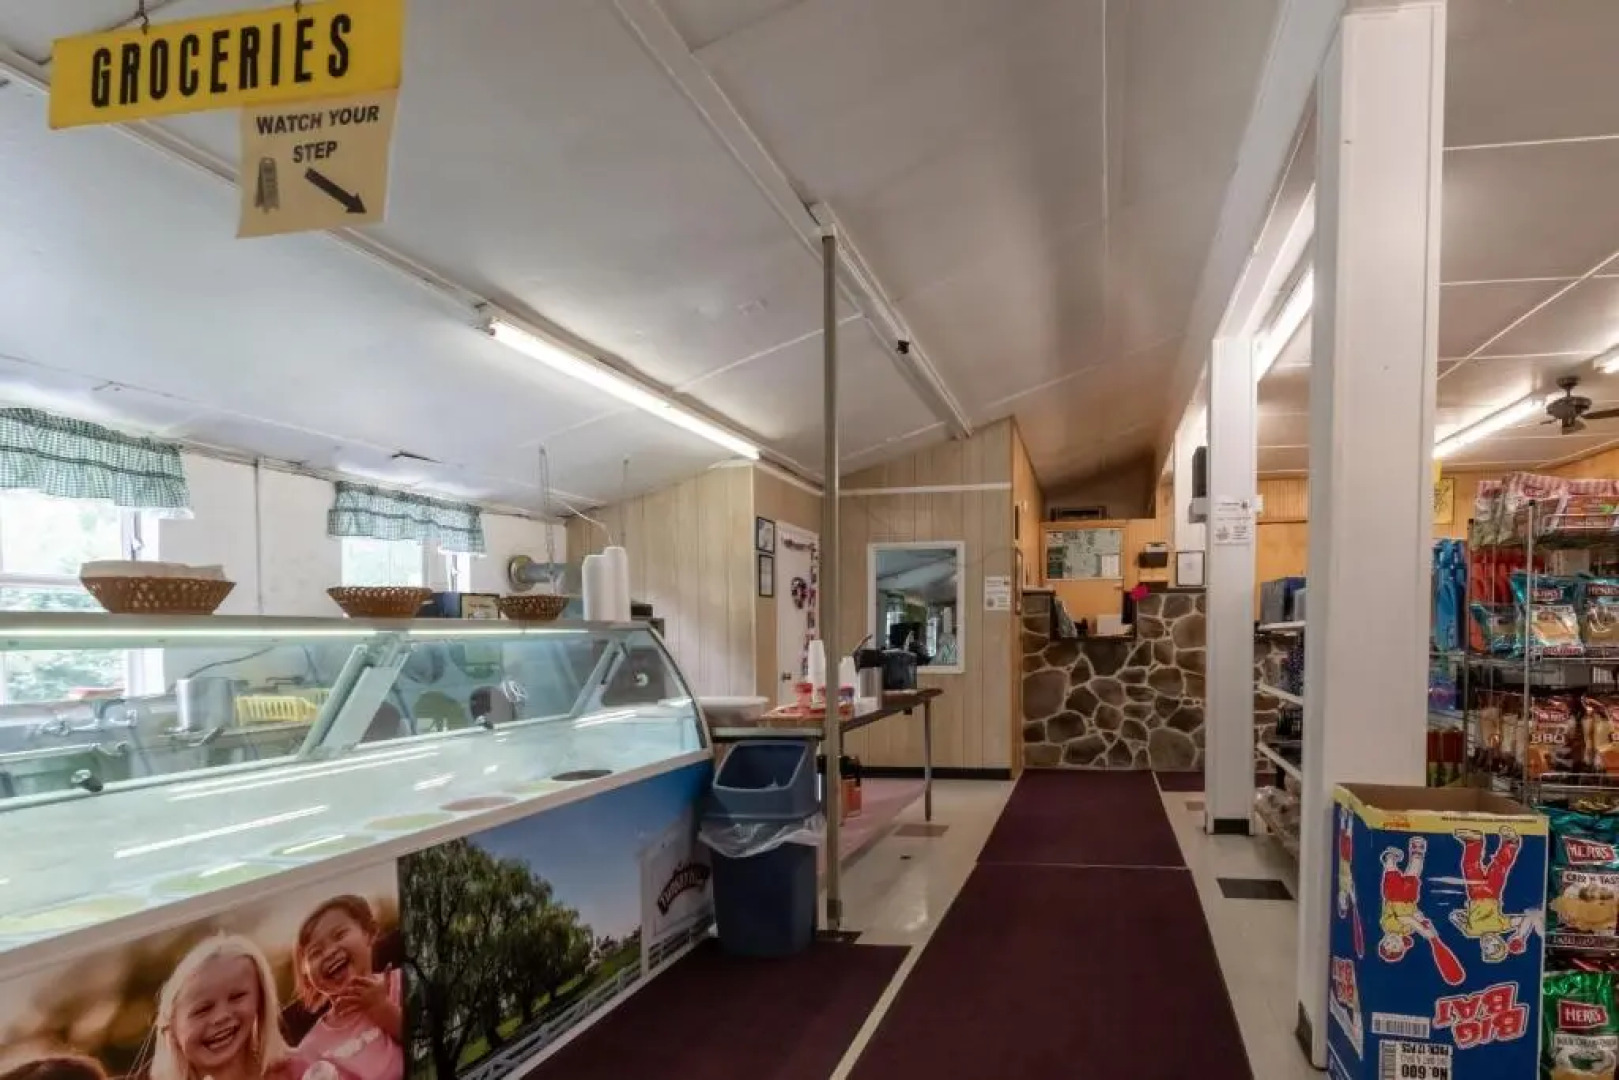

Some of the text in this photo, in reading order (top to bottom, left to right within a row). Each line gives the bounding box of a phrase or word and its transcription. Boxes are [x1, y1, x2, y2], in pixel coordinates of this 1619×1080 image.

[91, 14, 351, 108] GROCERIES
[256, 105, 380, 136] WATCH YOUR
[292, 141, 338, 164] STEP
[1454, 1009, 1524, 1046] BIG
